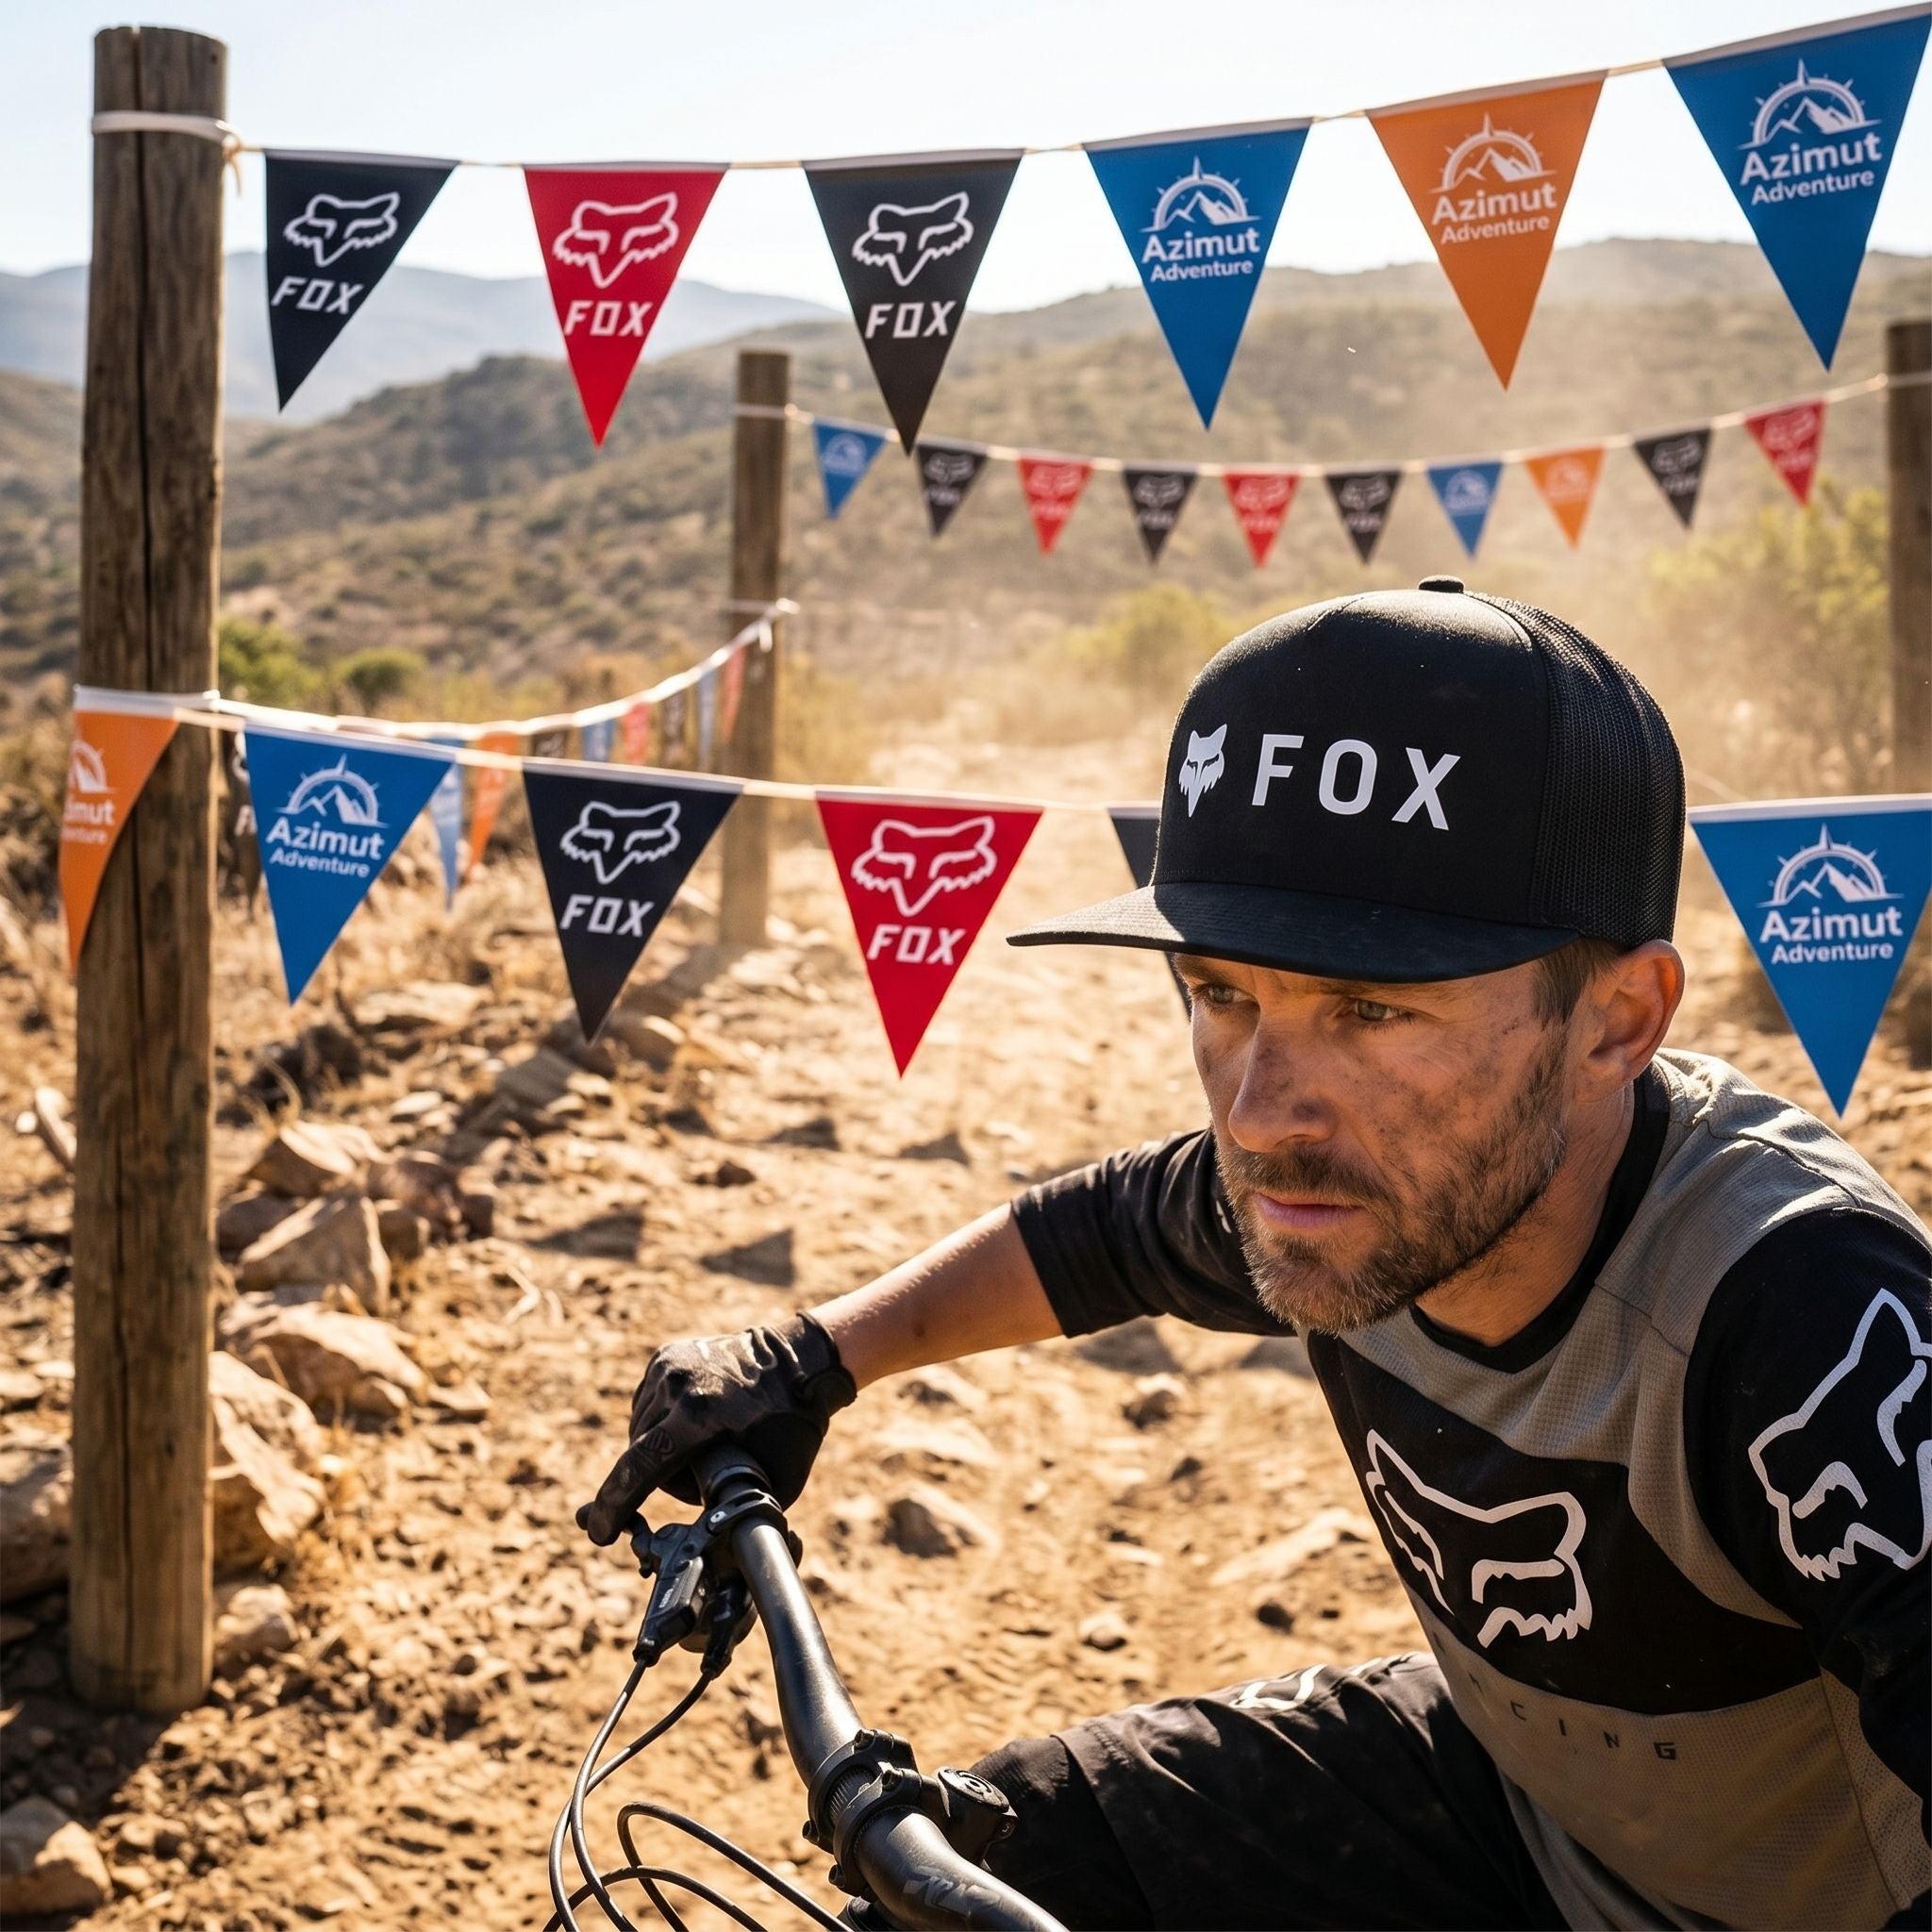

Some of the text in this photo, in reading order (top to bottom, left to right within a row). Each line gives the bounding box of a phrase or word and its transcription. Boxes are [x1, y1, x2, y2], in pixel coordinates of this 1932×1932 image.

[1740, 133, 1883, 186] Azimut
[1431, 183, 1558, 227] Azimut
[1751, 169, 1875, 206] Adventure
[1141, 228, 1262, 263] Azimut
[1440, 214, 1552, 243] Adventure
[1149, 259, 1254, 283] Adventure
[270, 276, 364, 316] FOX
[563, 299, 652, 338] FOX
[864, 299, 951, 339] FOX
[1251, 733, 1461, 831] FOX
[266, 817, 385, 859] Azimut
[270, 847, 370, 878] Adventure
[560, 894, 654, 937] FOX
[1759, 906, 1904, 947] Azimut
[867, 924, 966, 966] FOX
[1772, 933, 1894, 964] Adventure
